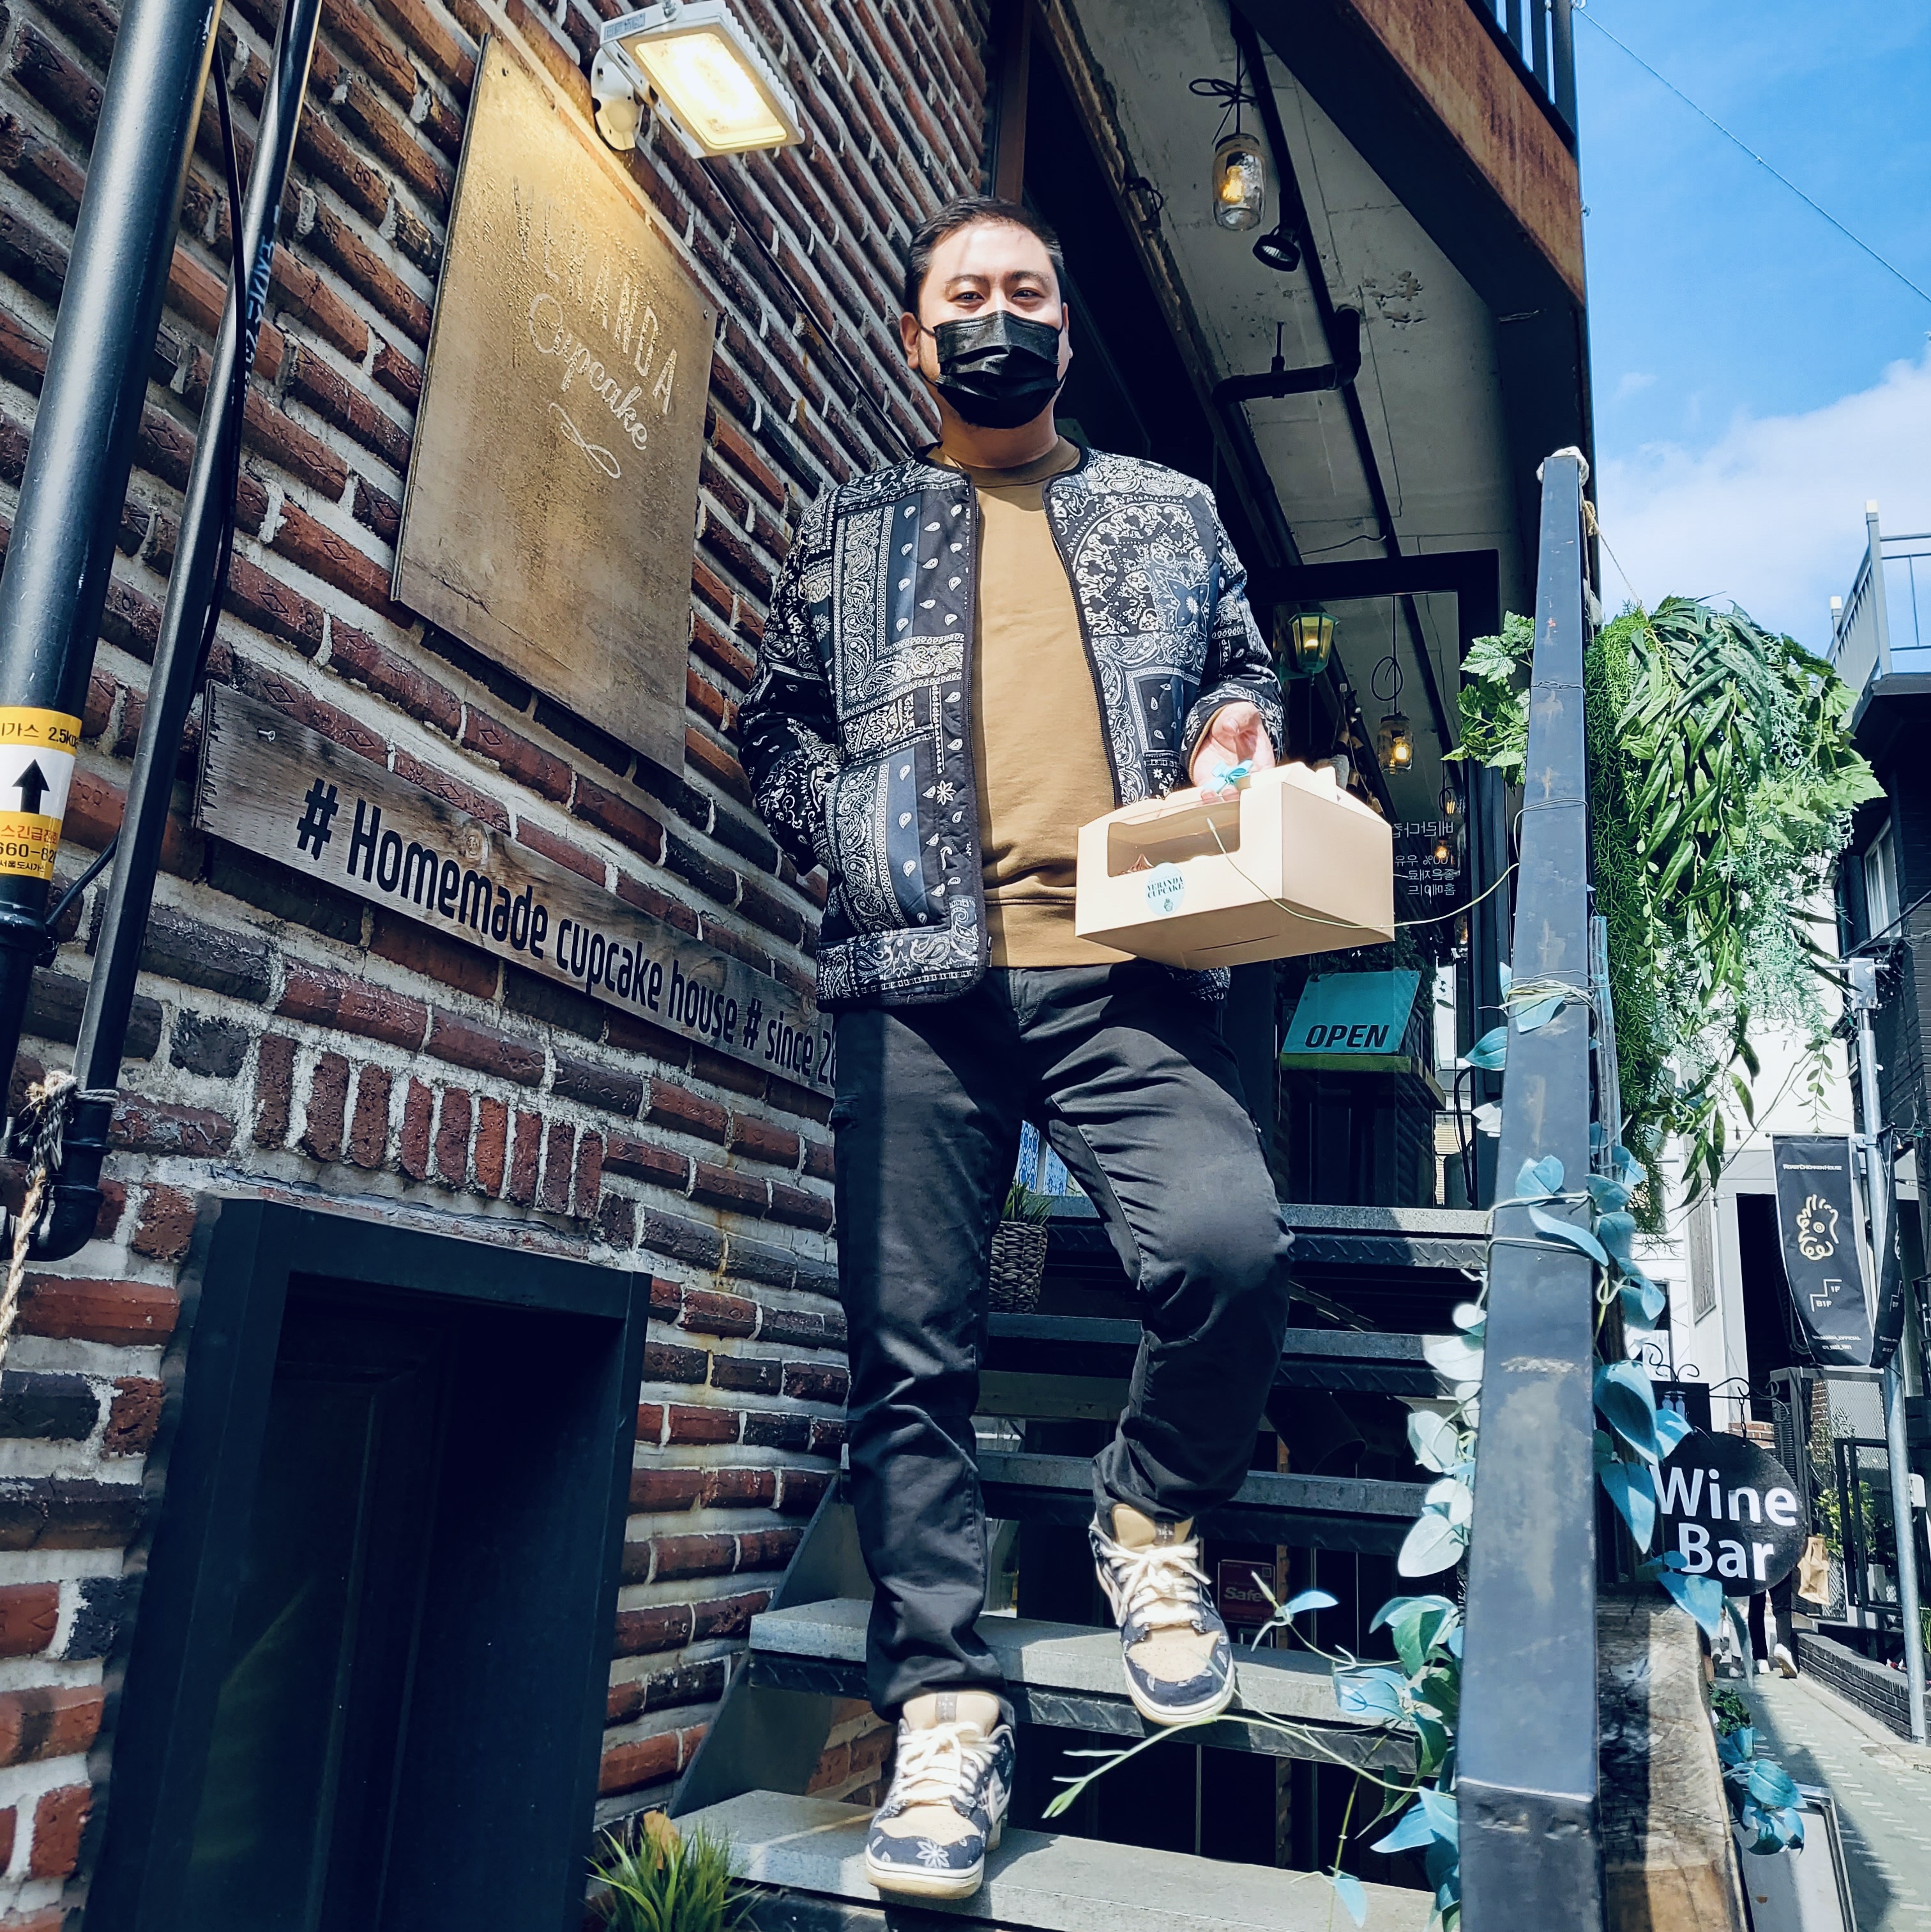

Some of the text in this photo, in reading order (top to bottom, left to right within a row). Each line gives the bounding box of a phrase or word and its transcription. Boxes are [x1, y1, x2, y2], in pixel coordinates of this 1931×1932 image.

[528, 293, 648, 451] Cupcake
[1147, 876, 1183, 892] VERANDA
[1147, 882, 1185, 899] CUPCAKE
[296, 778, 339, 861] #
[347, 798, 549, 960] Homemade
[556, 918, 663, 1010] cupcake
[667, 959, 738, 1044] house
[742, 997, 764, 1051] #
[764, 1011, 814, 1077] since
[1305, 1024, 1390, 1048] OPEN
[1649, 1464, 1798, 1526] Wine
[1677, 1522, 1775, 1581] Bar
[1223, 1586, 1263, 1602] Safe
